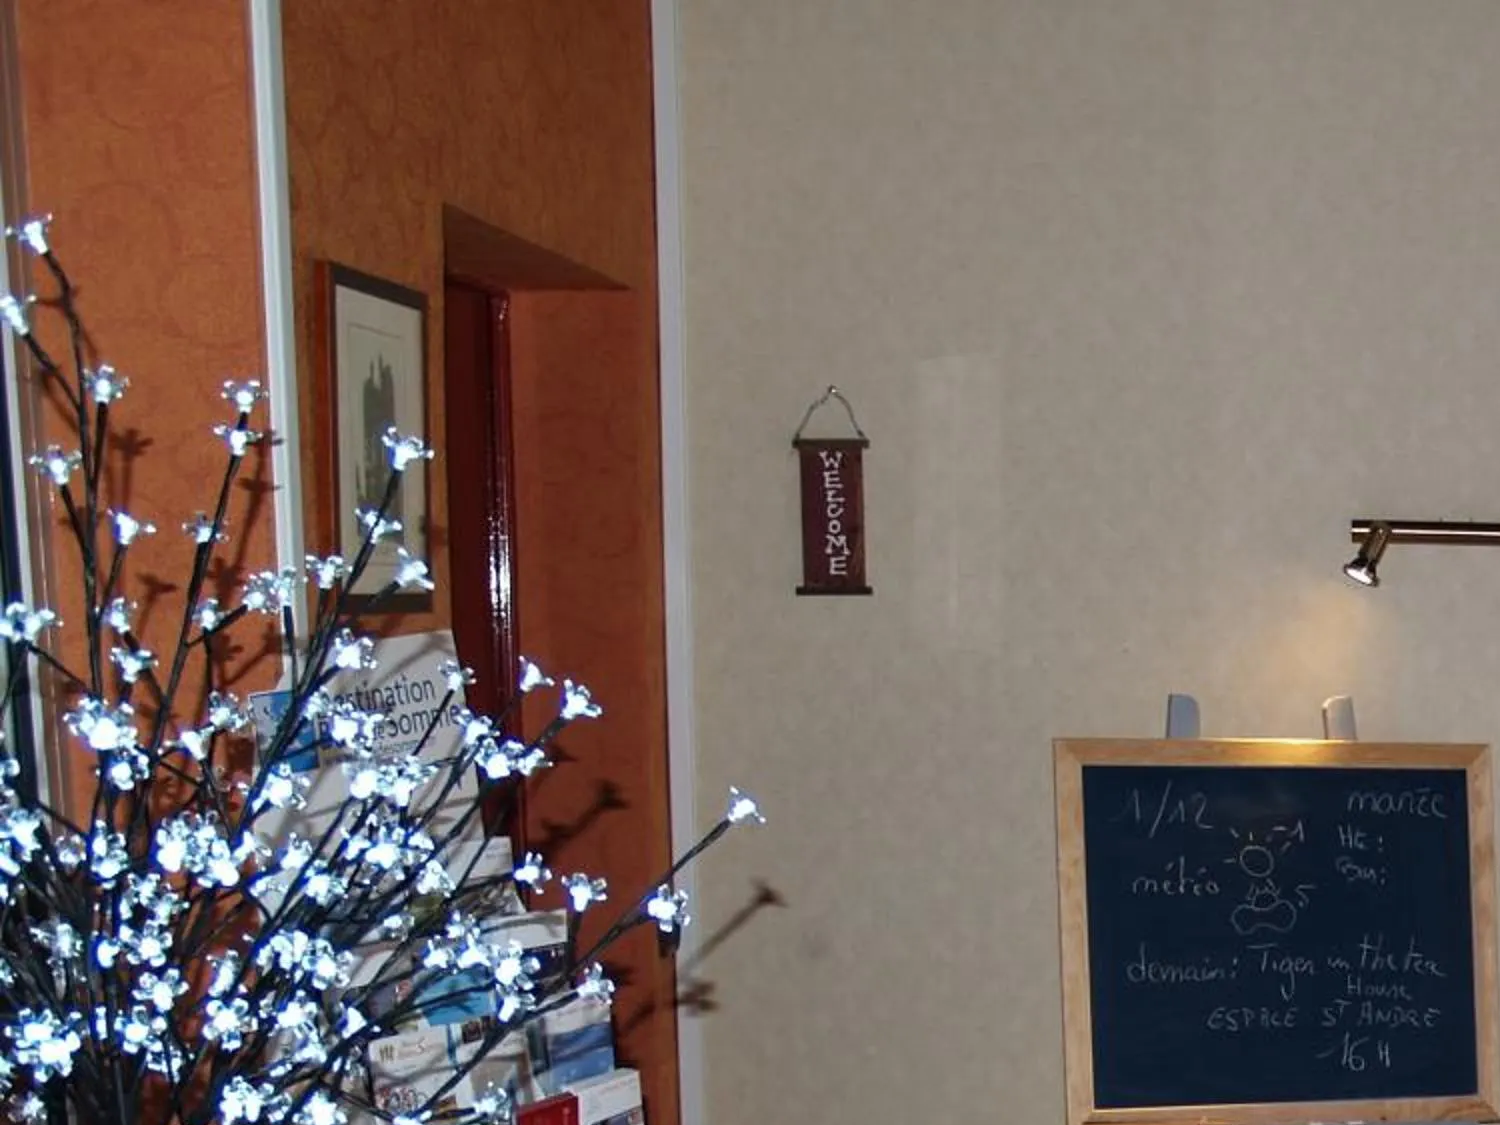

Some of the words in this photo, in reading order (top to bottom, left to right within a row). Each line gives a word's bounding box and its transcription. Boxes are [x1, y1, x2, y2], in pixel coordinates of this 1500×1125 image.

[818, 450, 851, 576] WELCOME
[1359, 933, 1396, 972] the
[1207, 1006, 1299, 1032] ESPACE
